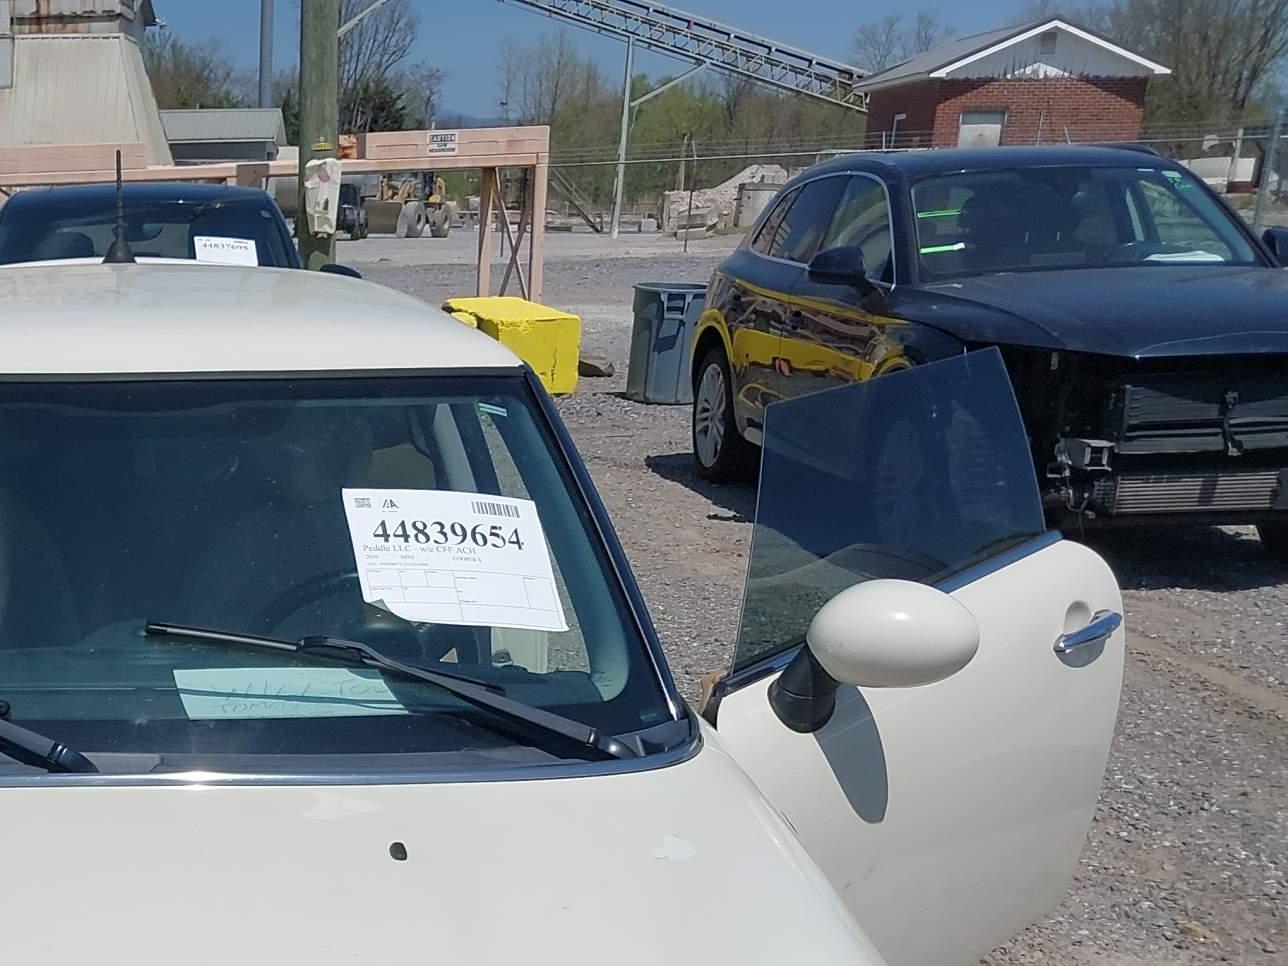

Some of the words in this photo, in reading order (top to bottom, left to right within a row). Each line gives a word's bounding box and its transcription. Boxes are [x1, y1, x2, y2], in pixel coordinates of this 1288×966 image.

[373, 519, 524, 550] 44839654
[362, 544, 391, 552] Peddle
[392, 544, 412, 552] LLC
[456, 547, 476, 555] ACH
